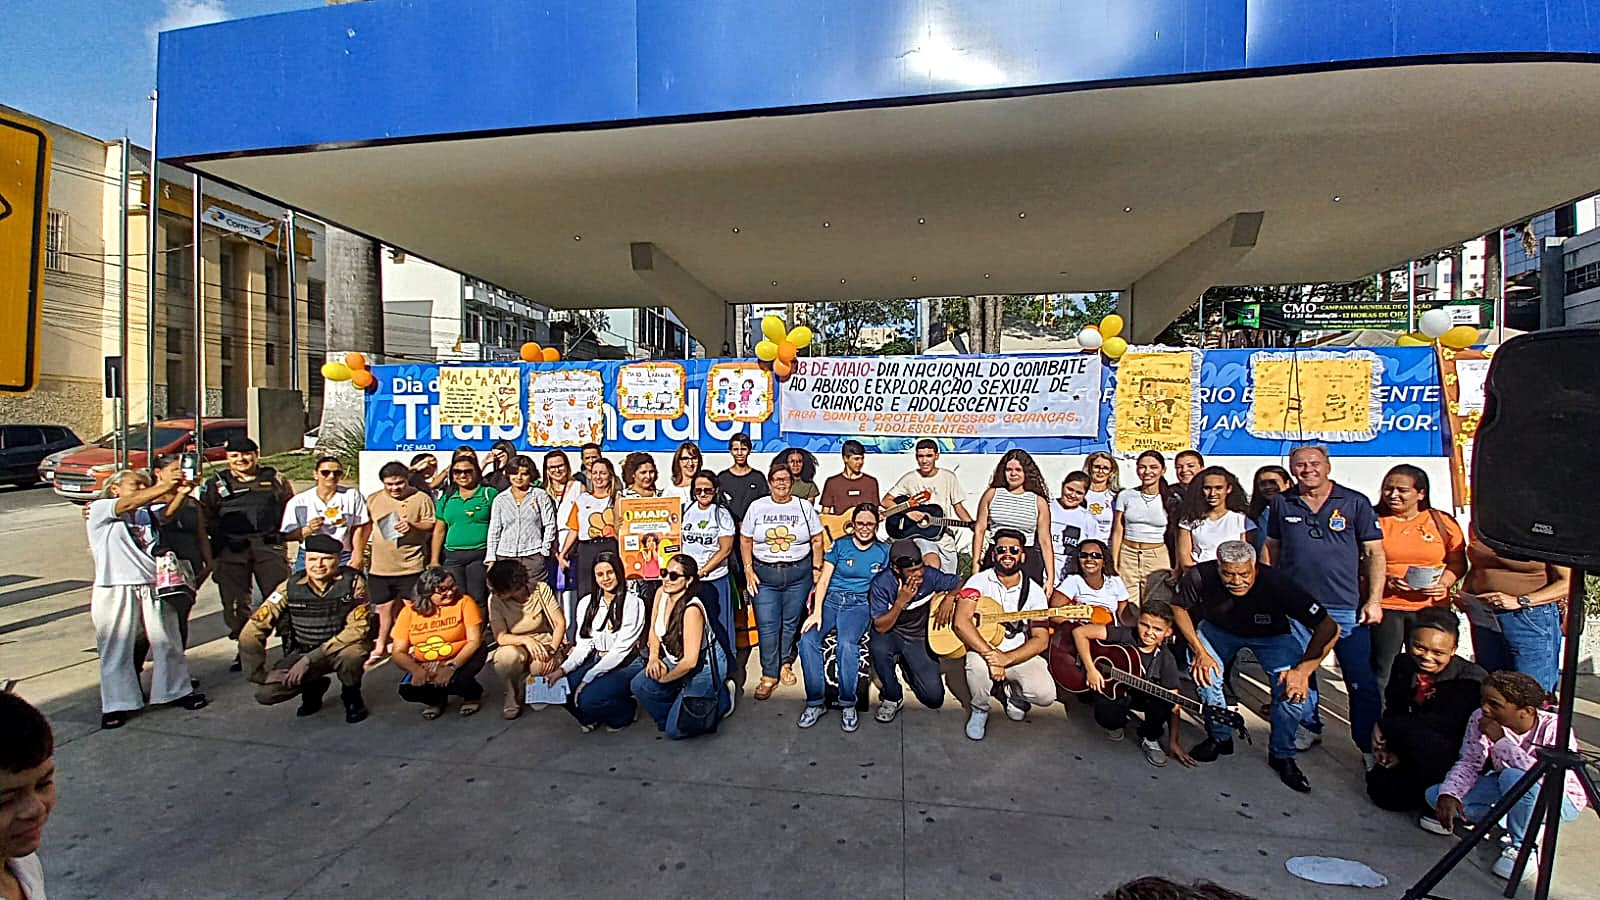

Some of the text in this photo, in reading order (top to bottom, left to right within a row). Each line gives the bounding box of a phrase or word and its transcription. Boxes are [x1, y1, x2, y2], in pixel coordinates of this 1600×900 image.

[1282, 303, 1317, 313] CMO
[810, 362, 830, 376] DE
[876, 362, 900, 377] DIA
[902, 362, 984, 378] NACIONAL
[988, 362, 1010, 377] DO
[1013, 358, 1088, 377] COMBATE
[392, 376, 423, 393] Dia
[441, 369, 519, 386] MAIO LARANJA
[788, 377, 807, 392] AO
[811, 378, 860, 394] ABUSO
[864, 379, 874, 394] E
[874, 377, 973, 396] EXPLORAÇÃO
[978, 378, 1040, 395] SEXUAL
[1048, 376, 1072, 392] DE
[1377, 385, 1440, 402] ENTE
[811, 394, 1030, 412] CRIANÇAS E ADOLESCENTES
[872, 413, 936, 423] PROTEJA
[943, 413, 996, 423] NOSSAS
[1378, 414, 1439, 431] HOR.
[858, 423, 866, 432] E
[403, 443, 414, 451] DE
[415, 443, 436, 451] MAIO
[633, 510, 670, 519] MAIO
